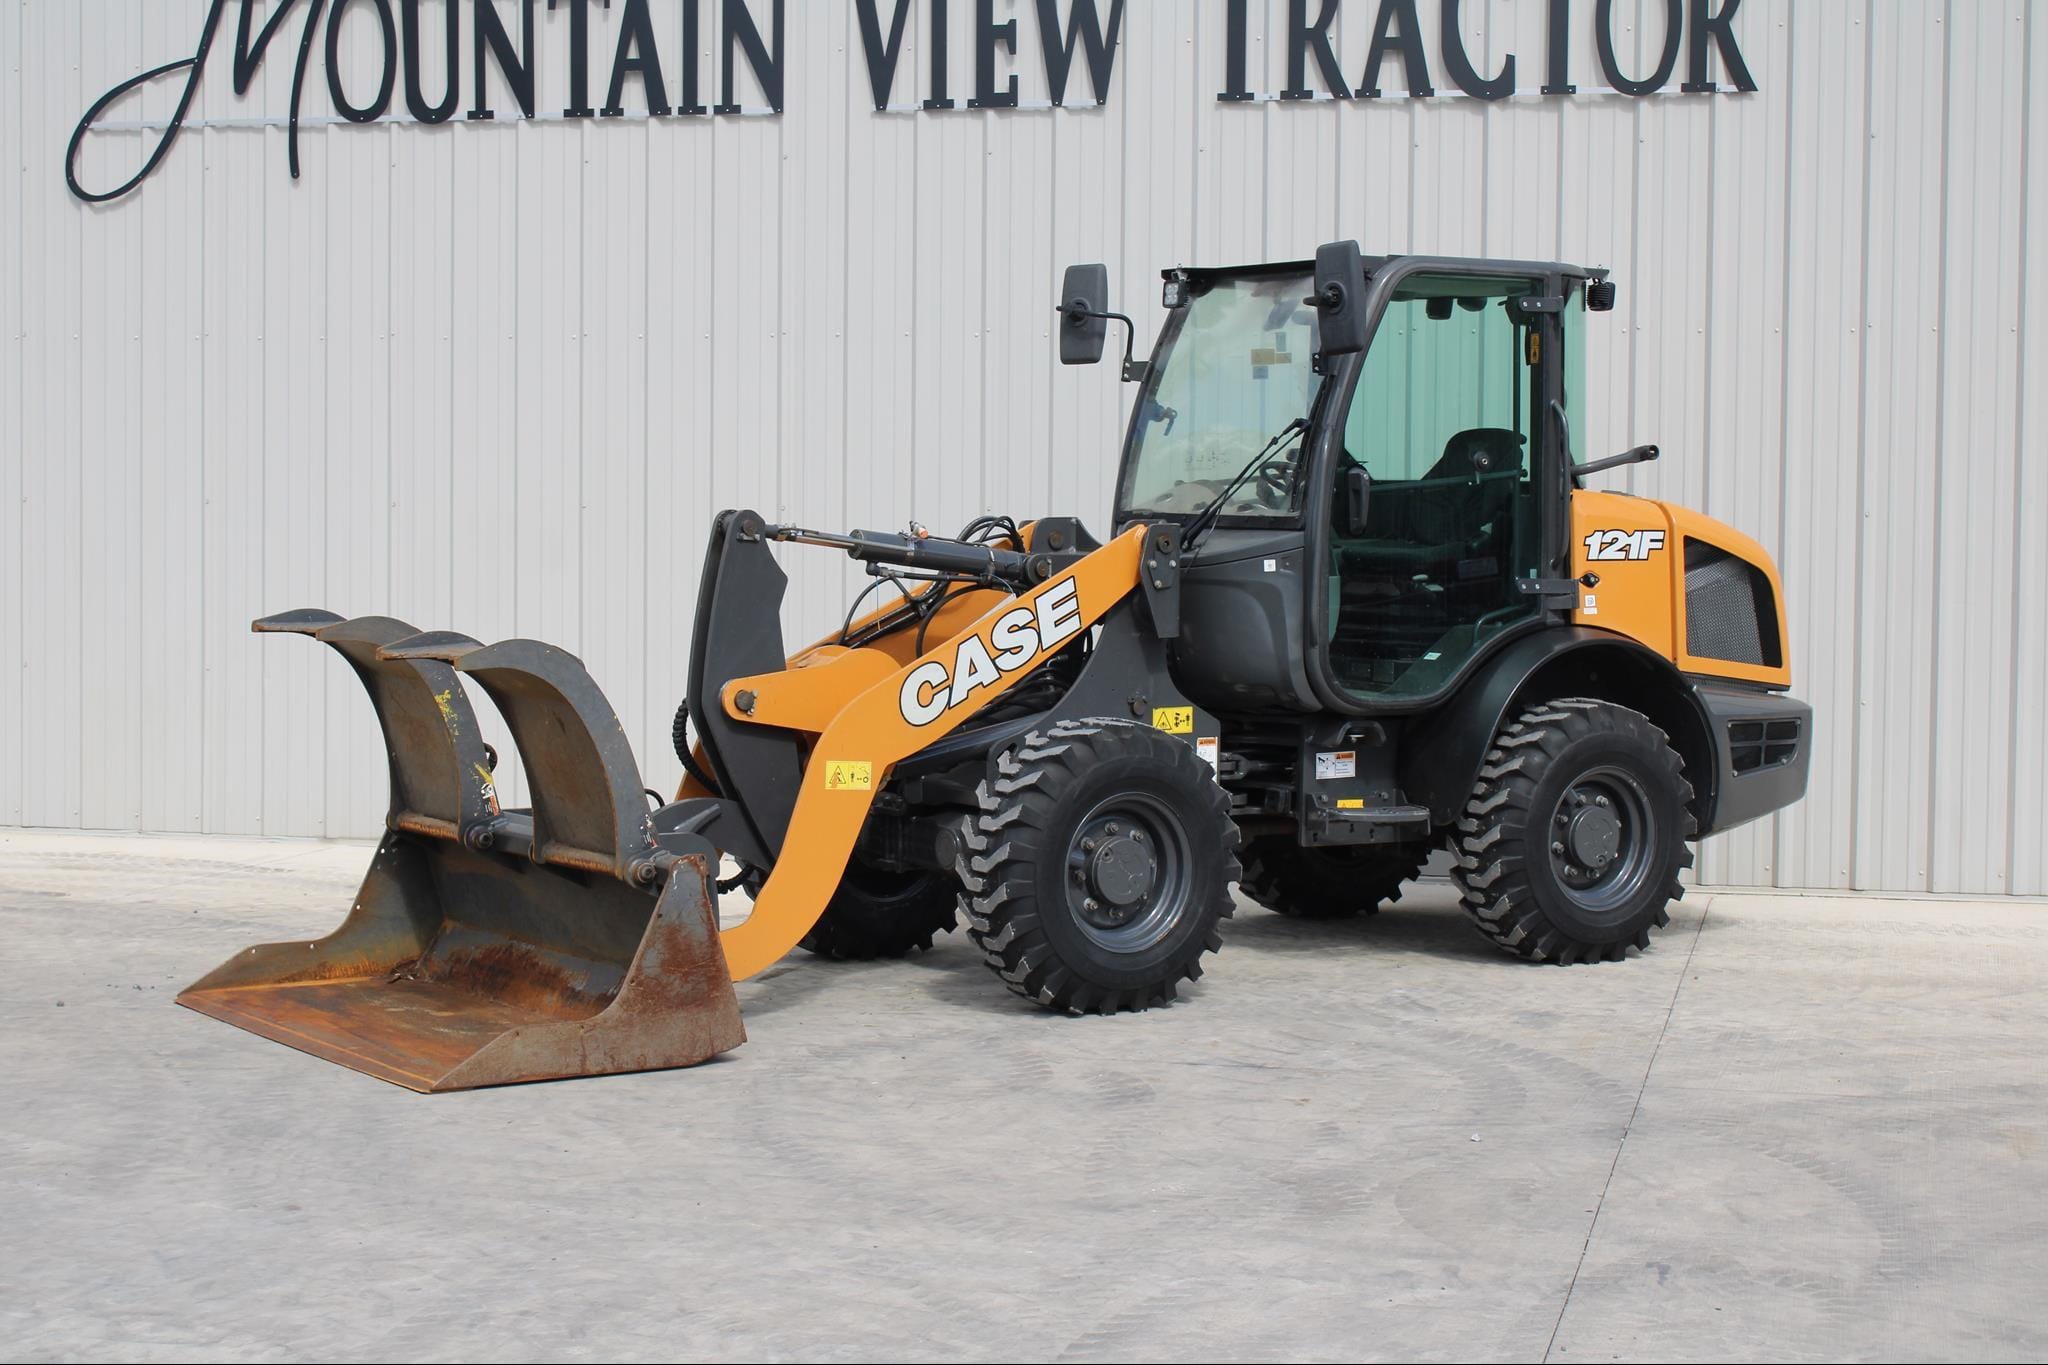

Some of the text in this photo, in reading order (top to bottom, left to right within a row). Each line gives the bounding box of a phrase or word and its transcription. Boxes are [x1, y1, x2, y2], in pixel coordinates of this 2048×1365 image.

[66, 0, 784, 202] MOUNTAIN
[854, 0, 1126, 109] VIEW
[1584, 529, 1666, 561] 121F
[900, 575, 1082, 726] CASE
